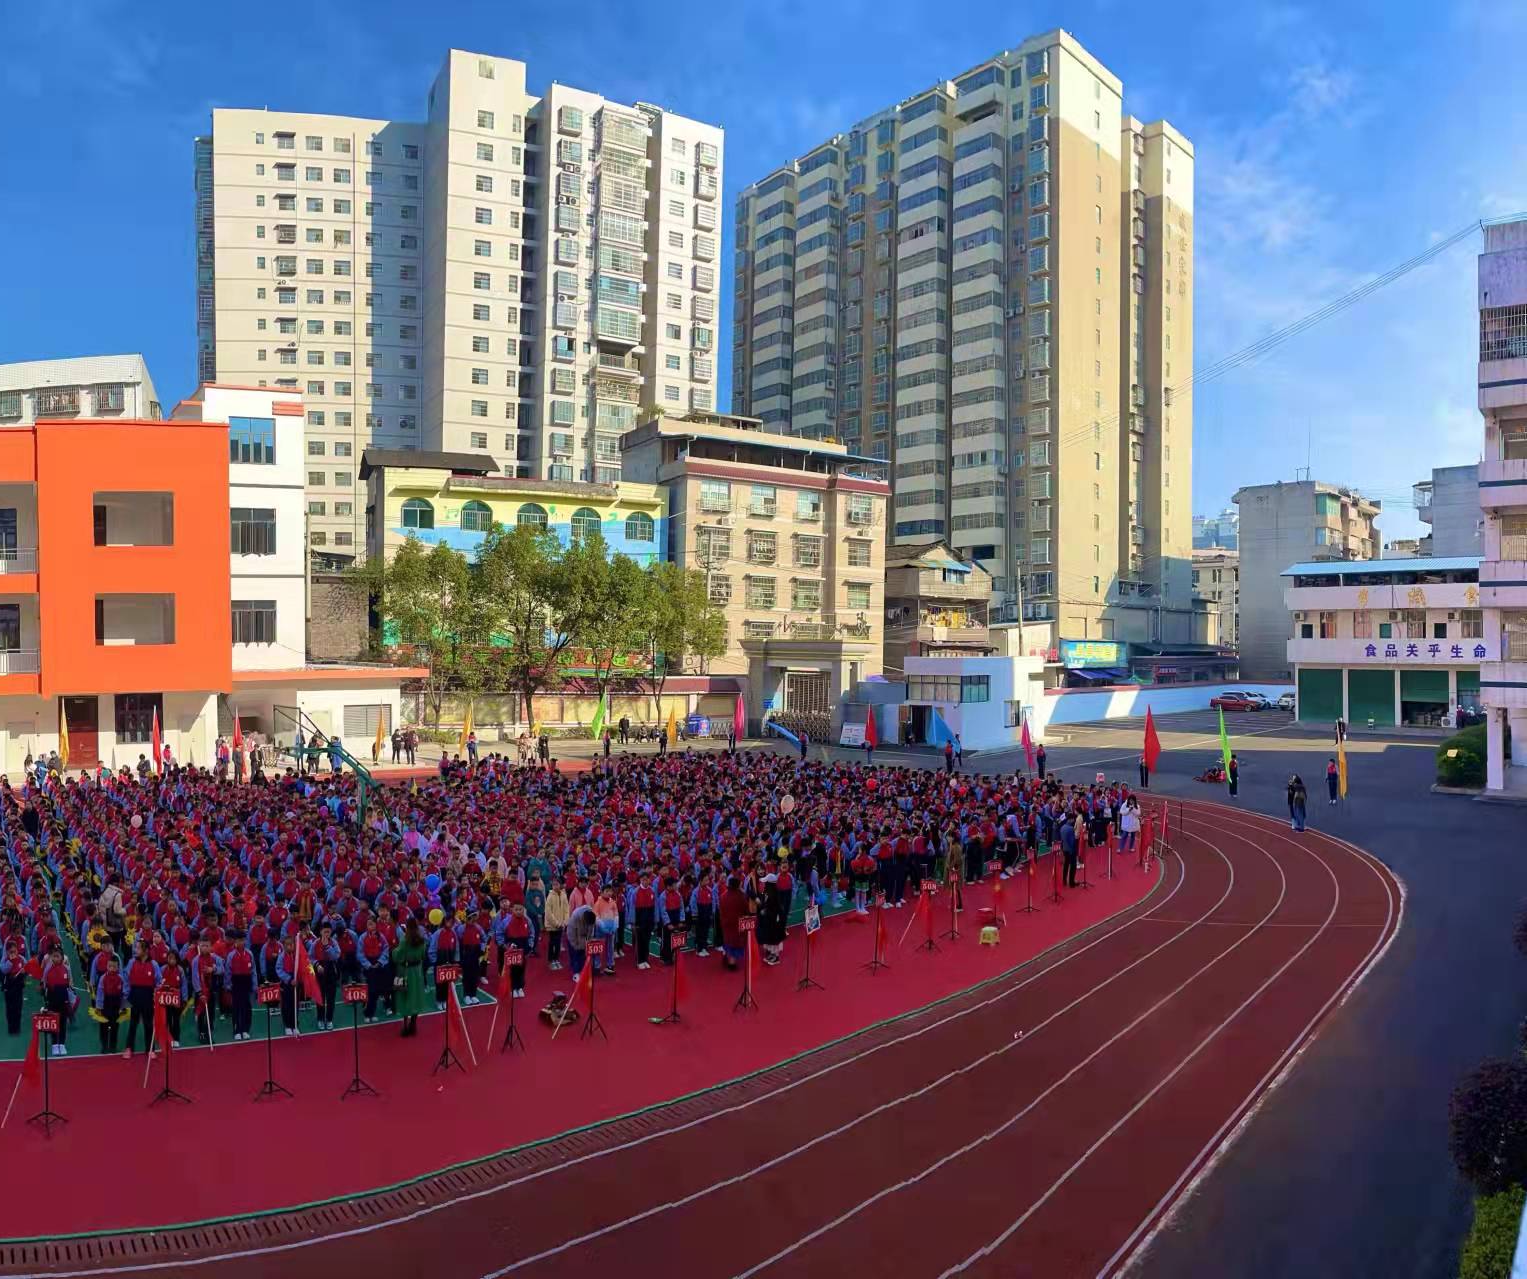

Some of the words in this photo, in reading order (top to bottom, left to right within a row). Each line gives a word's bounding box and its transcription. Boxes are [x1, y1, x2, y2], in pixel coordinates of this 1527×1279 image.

[1364, 643, 1487, 659] 食品关乎生命
[587, 943, 604, 954] 503
[505, 954, 522, 965] 502
[439, 971, 457, 981] 501
[158, 994, 179, 1006] 406
[259, 989, 279, 1001] 407
[345, 989, 367, 1001] 408
[35, 1019, 57, 1031] 405
